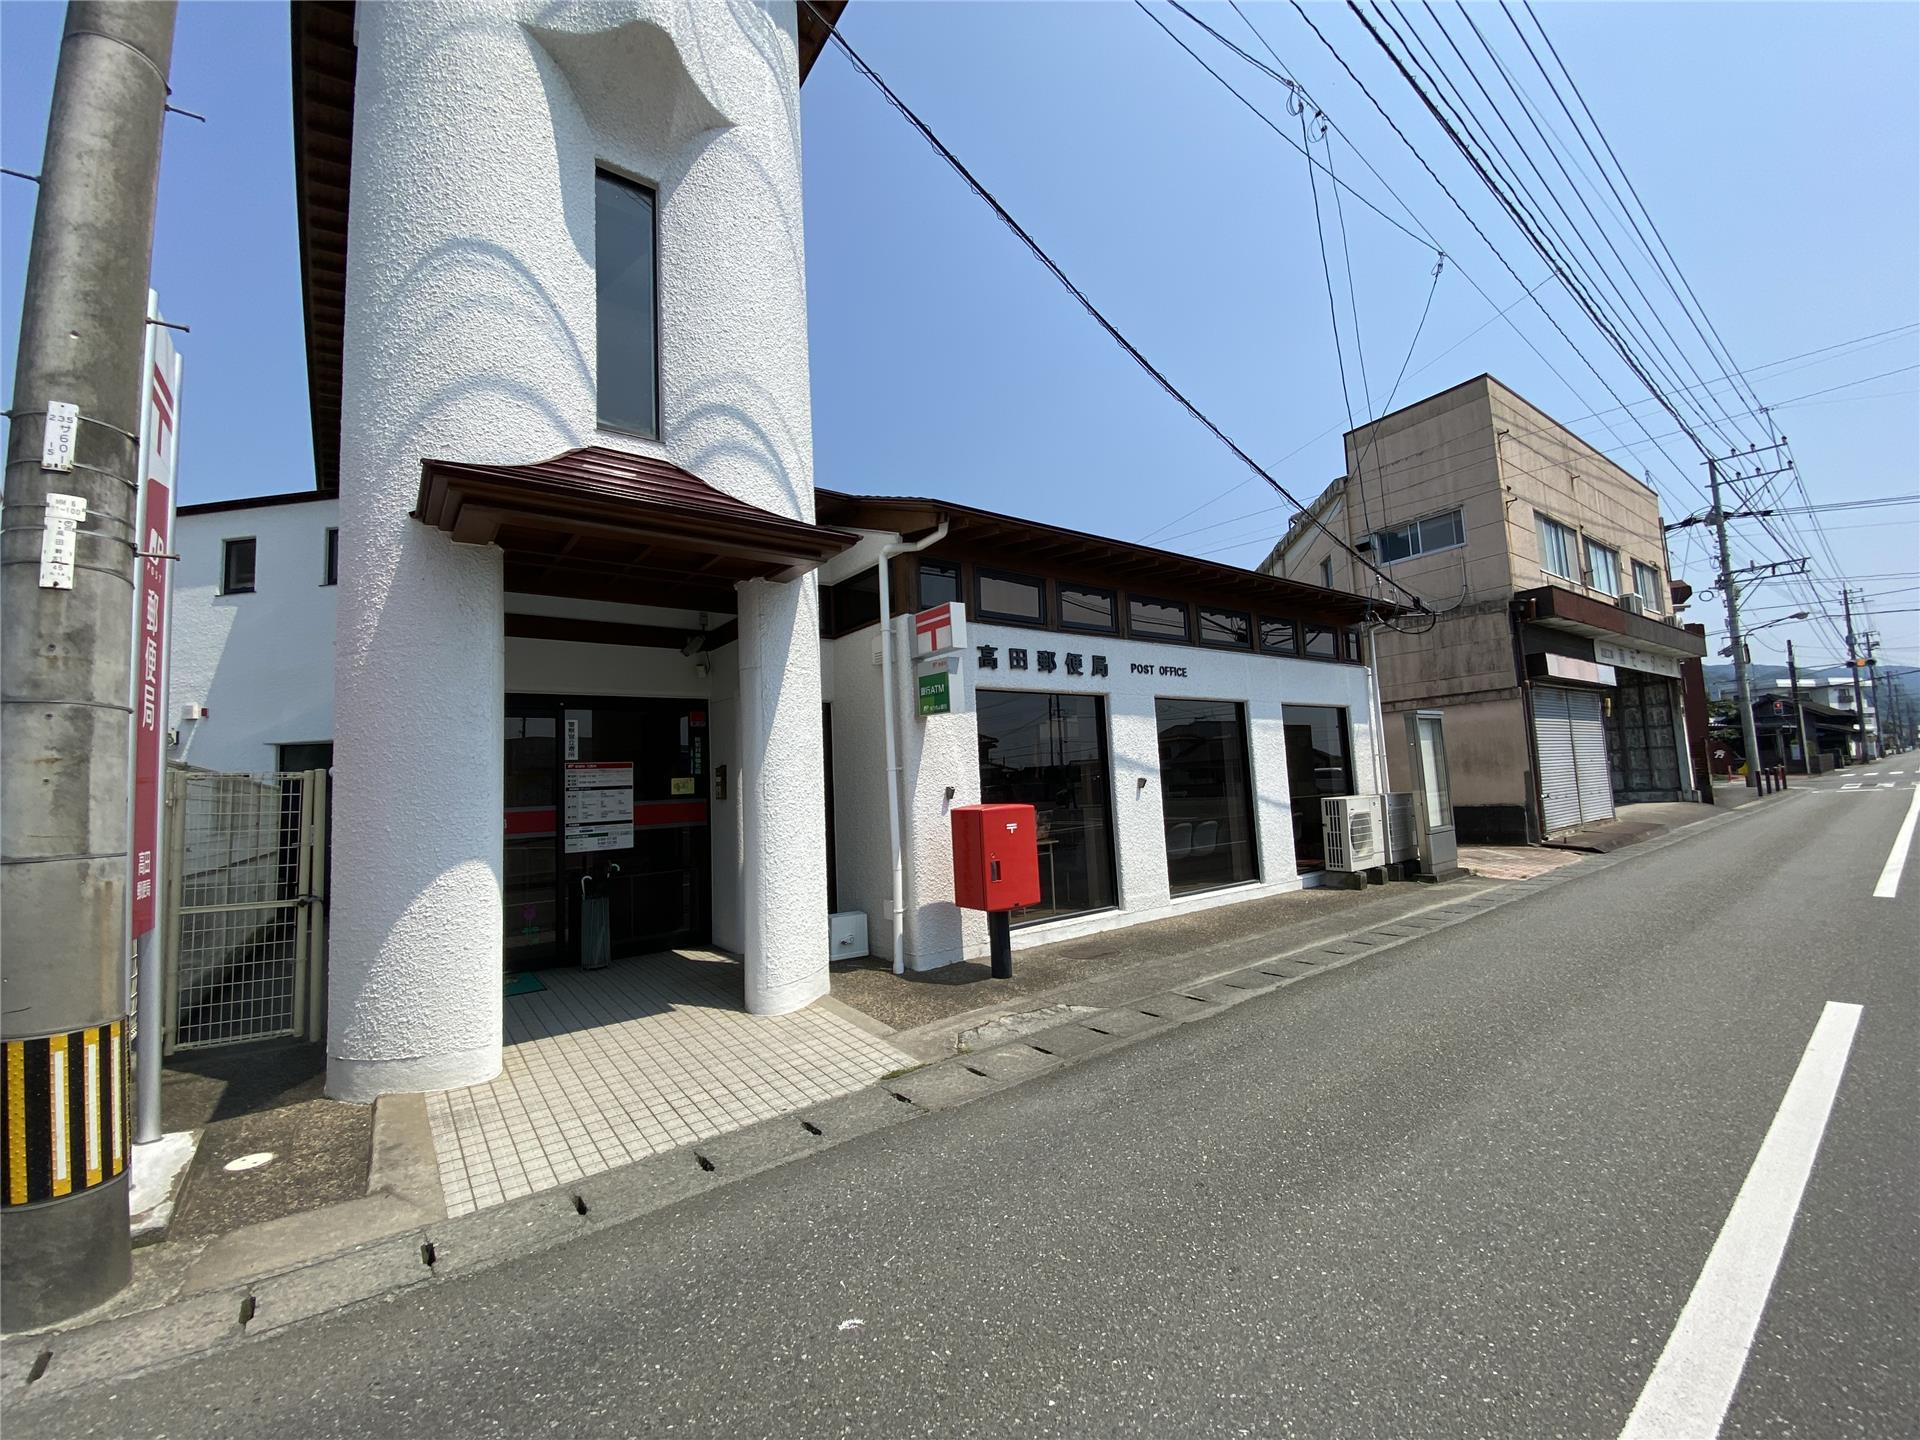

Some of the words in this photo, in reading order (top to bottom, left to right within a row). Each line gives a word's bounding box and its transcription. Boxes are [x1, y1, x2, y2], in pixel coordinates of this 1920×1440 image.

[48, 414, 74, 424] 235
[143, 588, 160, 732] 郵便局
[976, 644, 1109, 678] 高田郵便局
[1130, 662, 1155, 675] POST
[1159, 664, 1188, 678] OFFICE
